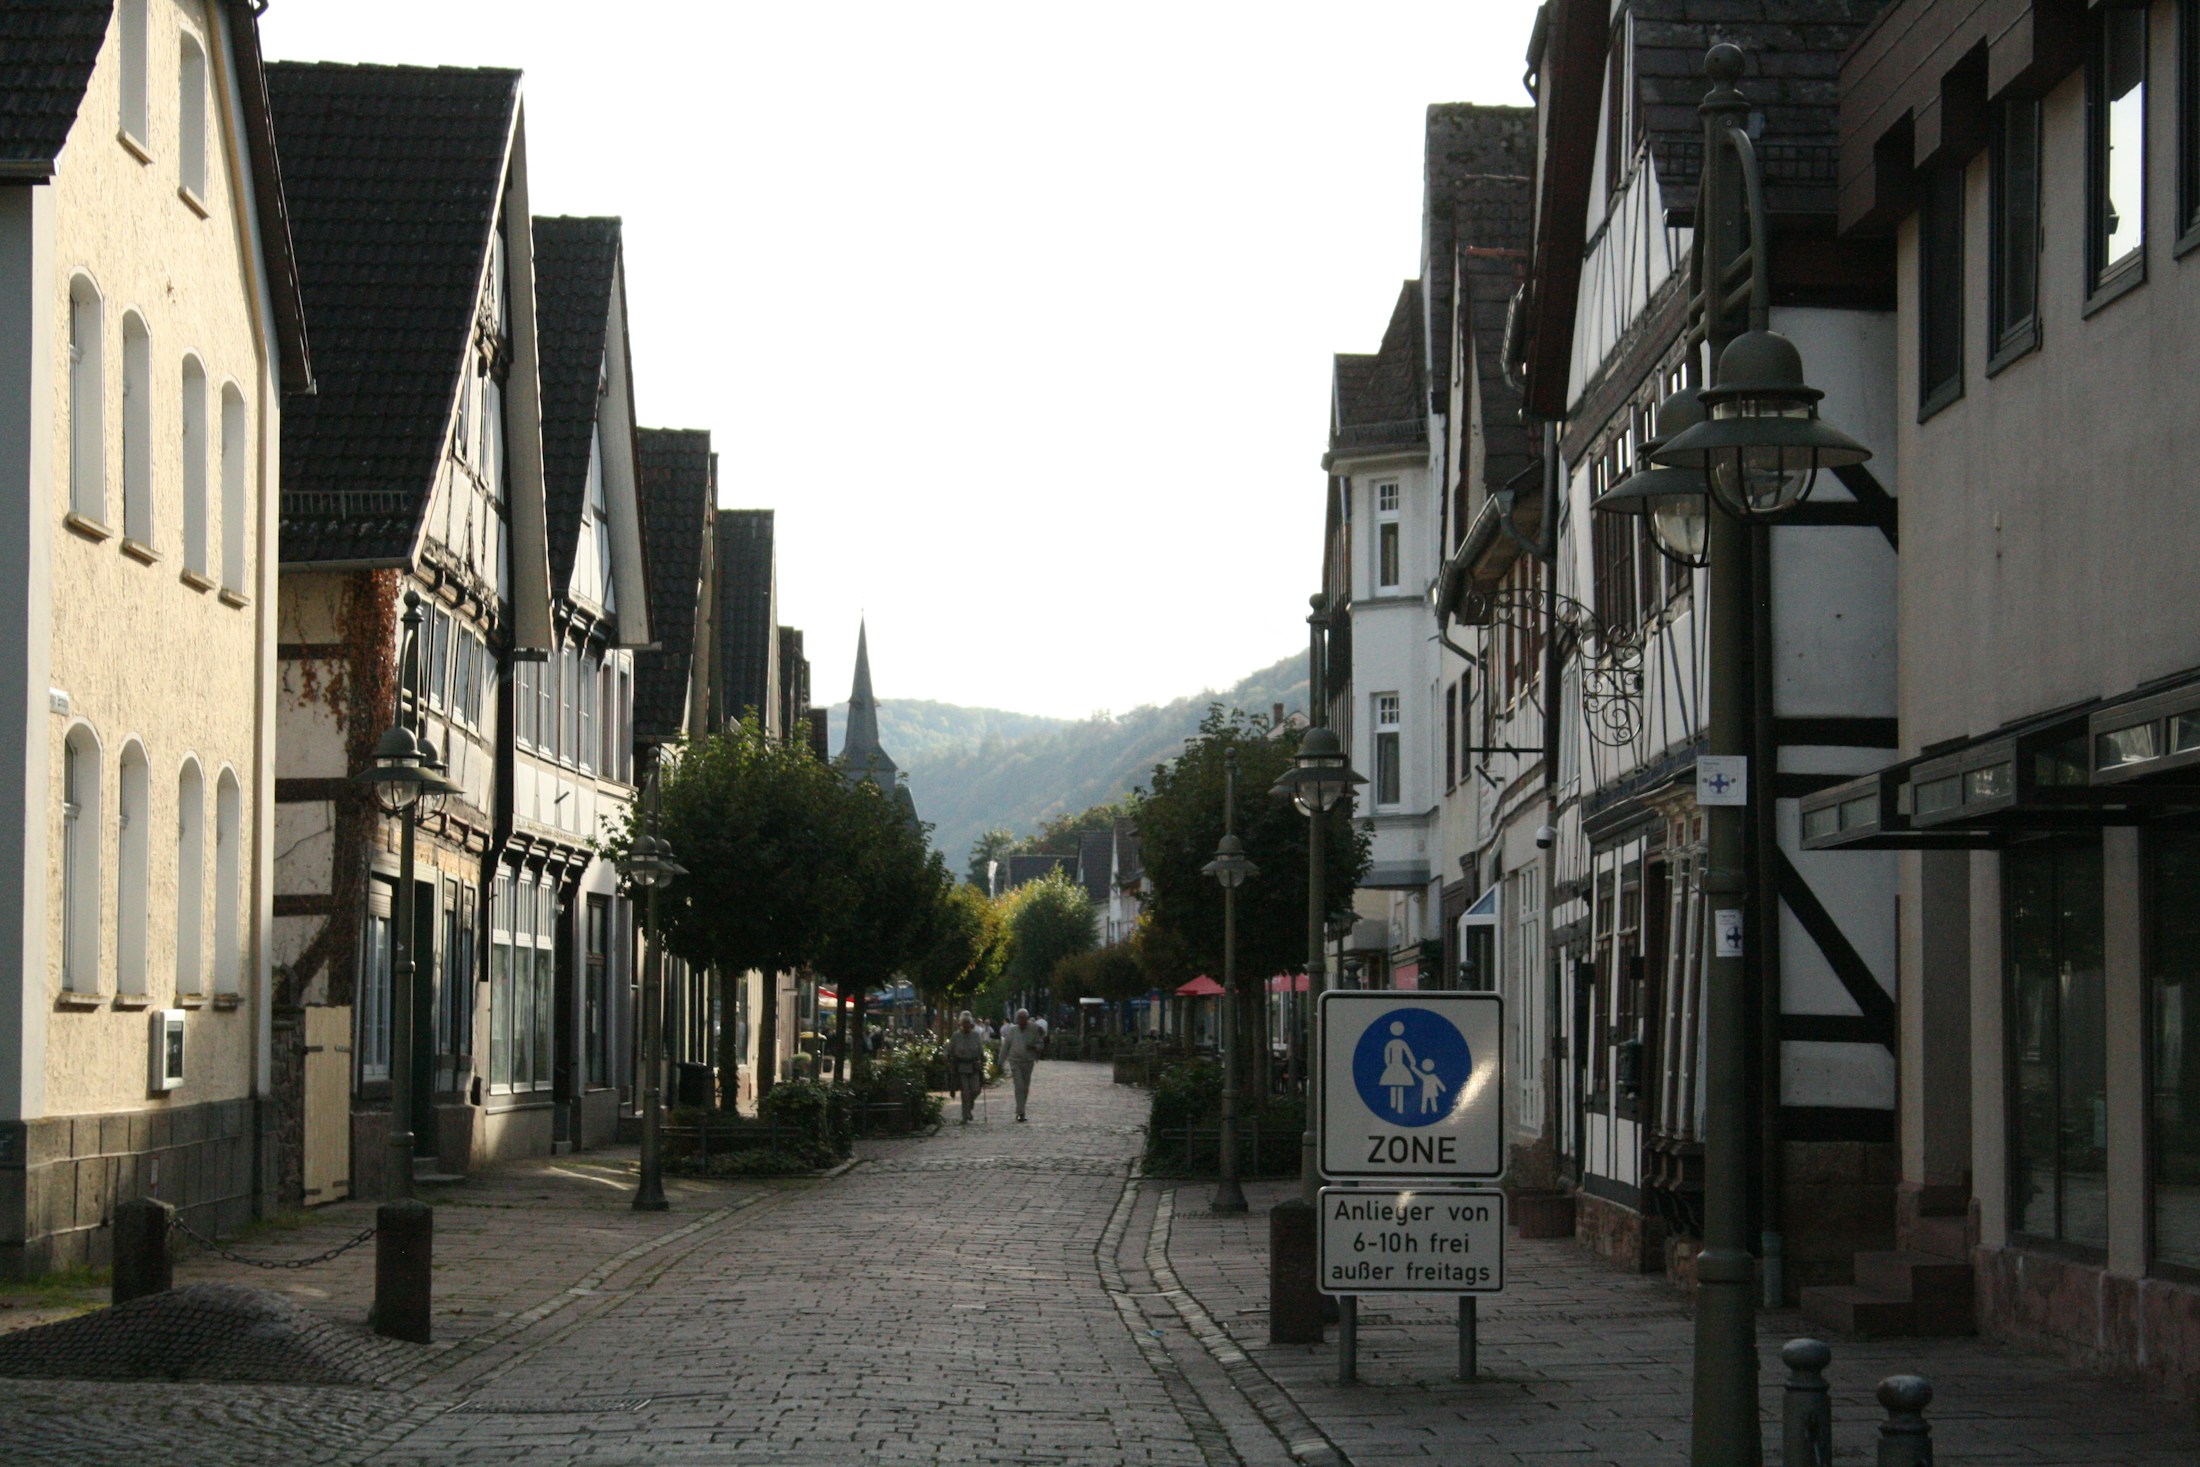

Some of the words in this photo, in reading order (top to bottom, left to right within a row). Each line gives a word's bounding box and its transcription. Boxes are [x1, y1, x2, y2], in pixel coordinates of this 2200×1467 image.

[1366, 1136, 1457, 1164] ZONE
[1334, 1200, 1434, 1226] Anlieger
[1448, 1206, 1489, 1221] von
[1430, 1233, 1469, 1253] frei
[1332, 1261, 1395, 1280] außer
[1406, 1262, 1490, 1286] freitags
